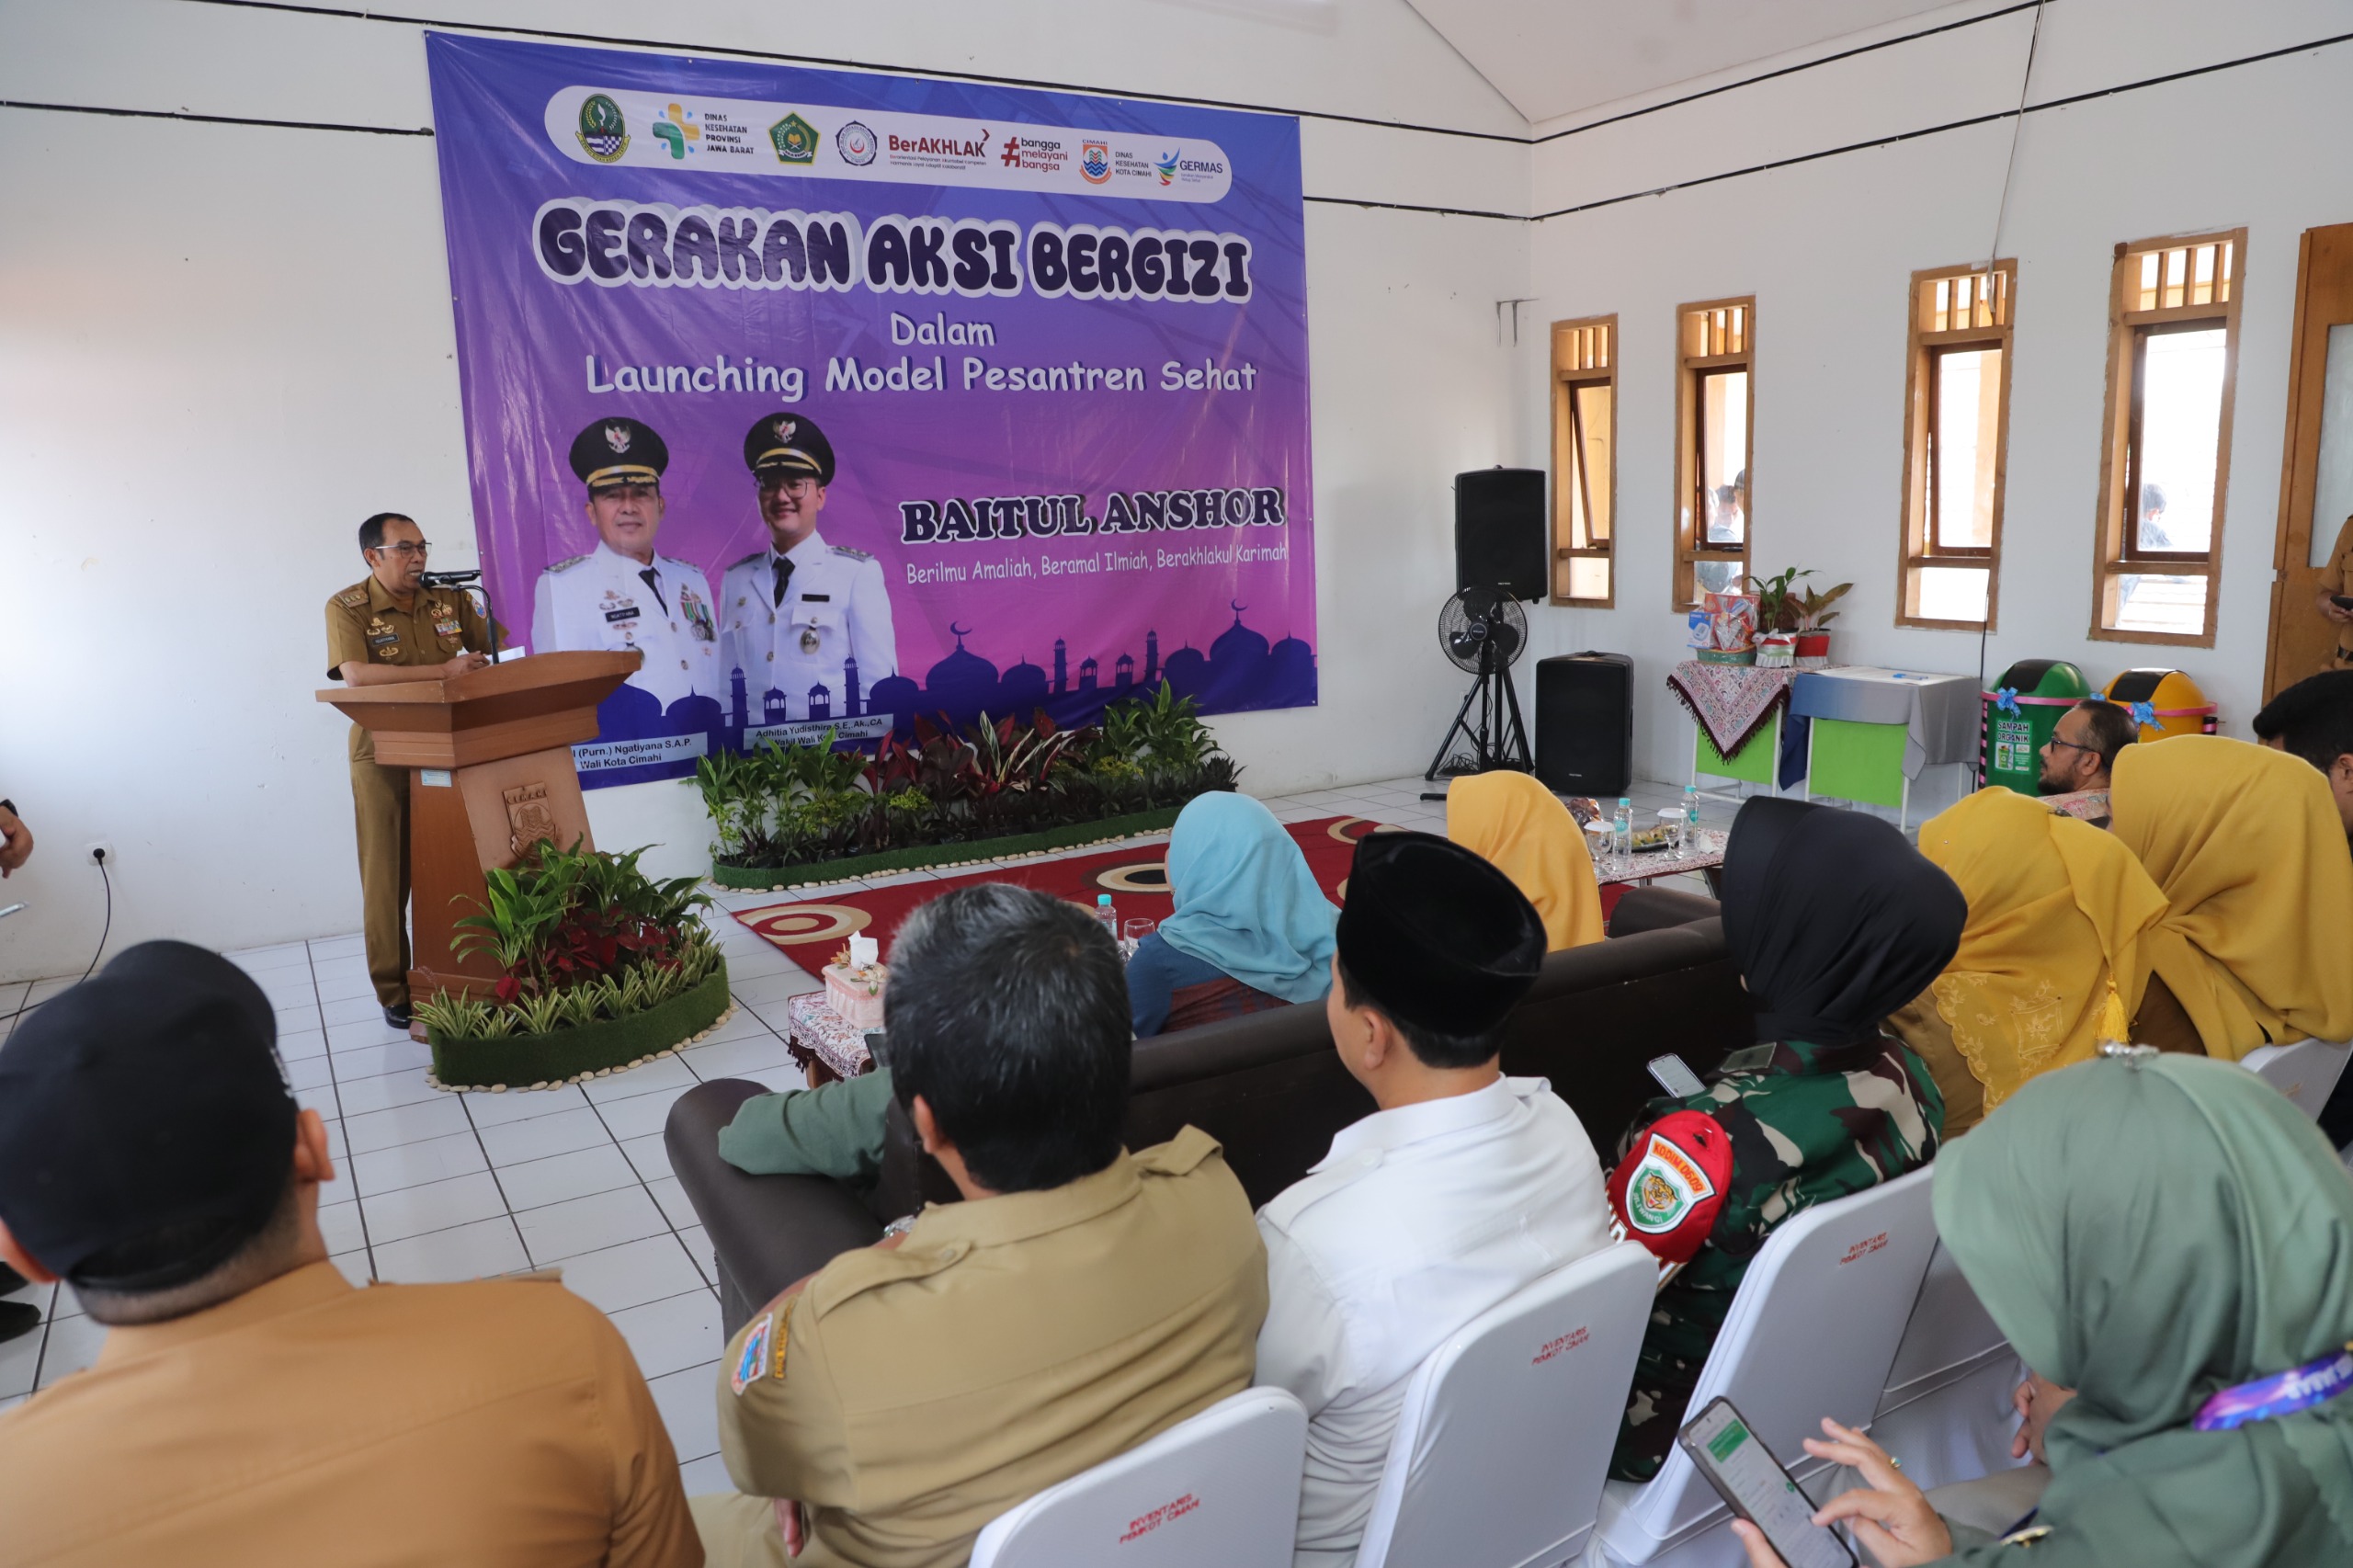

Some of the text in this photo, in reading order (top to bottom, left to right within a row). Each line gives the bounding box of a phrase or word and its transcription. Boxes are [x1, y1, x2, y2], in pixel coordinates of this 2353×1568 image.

[704, 113, 727, 121] DINAS
[705, 123, 747, 133] KESEHATAN
[706, 133, 741, 143] PROVINSI
[1021, 137, 1061, 152] bangga
[707, 144, 754, 154] JAWA BARAT
[888, 134, 987, 158] BerAKHLAK
[1021, 150, 1068, 162] melayani
[1115, 151, 1132, 159] DINAS
[1022, 160, 1060, 173] bangsa
[1115, 160, 1149, 168] KESEHATAN
[1179, 160, 1223, 174] GERMAS
[1115, 168, 1131, 176] KOTA
[536, 201, 1251, 301] GERAKAN AKSI BERGIZI
[891, 311, 995, 347] Dalam
[585, 354, 1257, 403] Launching Model Pesantren Sehat
[899, 487, 1286, 544] BAITUL ANSHOR
[906, 541, 1287, 585] Berilmu Amaliah, Beramal Ilmiah, Berakhlakul Karimah
[756, 728, 788, 737] Adhitia
[790, 723, 832, 734] Yudisthira
[1997, 721, 2029, 732] SAMPAH
[798, 735, 815, 744] Wali
[838, 730, 869, 739] Cimahi
[1997, 732, 2029, 743] ORGANIK
[578, 745, 612, 758] (Purn.)
[614, 741, 663, 755] Ngatiyana
[580, 753, 662, 769] Wali Kota Cimahi
[1653, 1142, 1705, 1193] KODIM 0609
